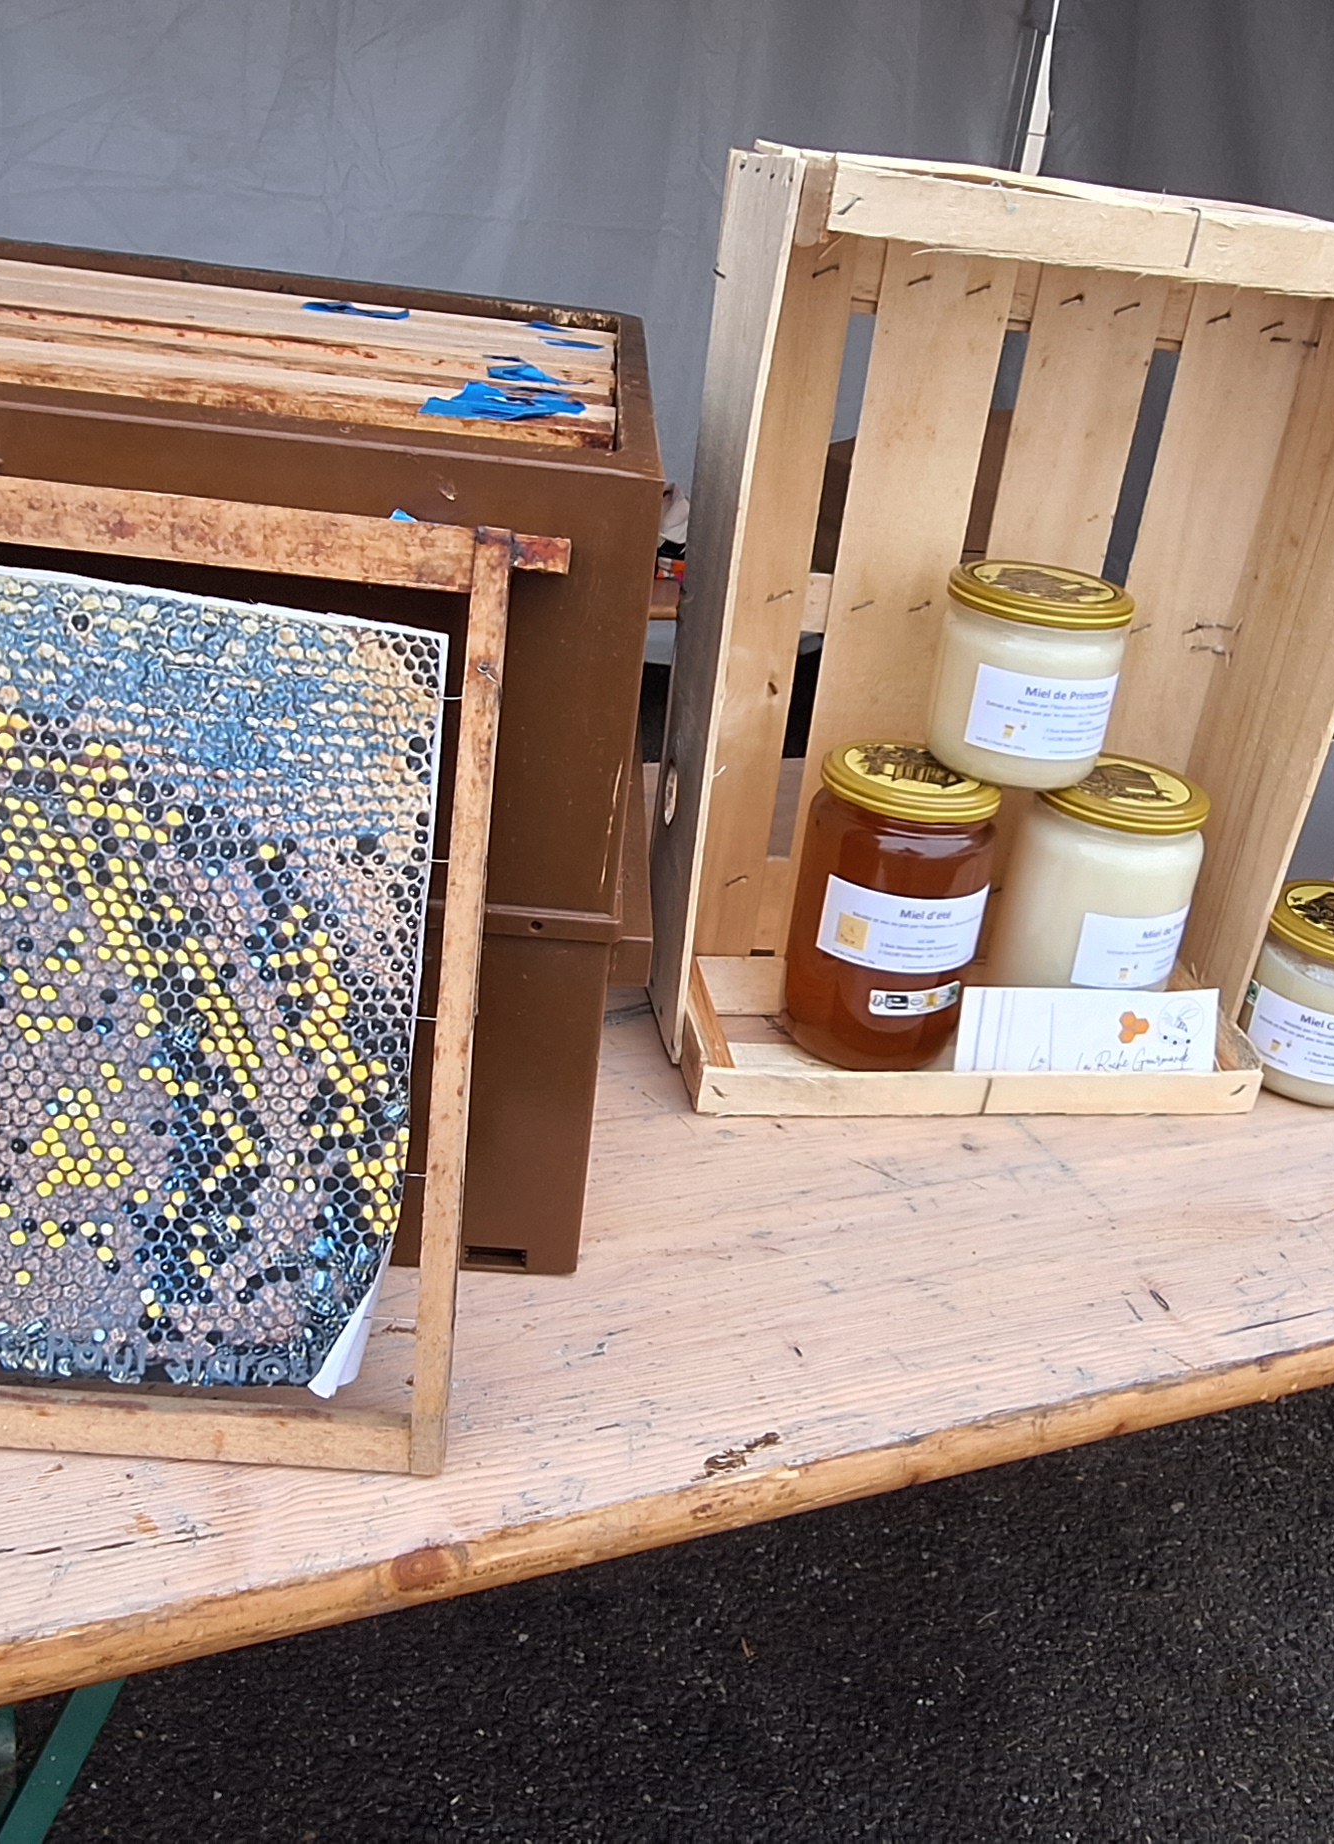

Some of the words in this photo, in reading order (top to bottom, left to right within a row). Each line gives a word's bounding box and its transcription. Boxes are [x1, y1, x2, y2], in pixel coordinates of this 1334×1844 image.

[1025, 686, 1052, 699] Miel
[1053, 689, 1067, 701] de
[899, 909, 925, 920] Miel
[1300, 1014, 1325, 1028] Miel
[46, 1332, 148, 1379] Paul
